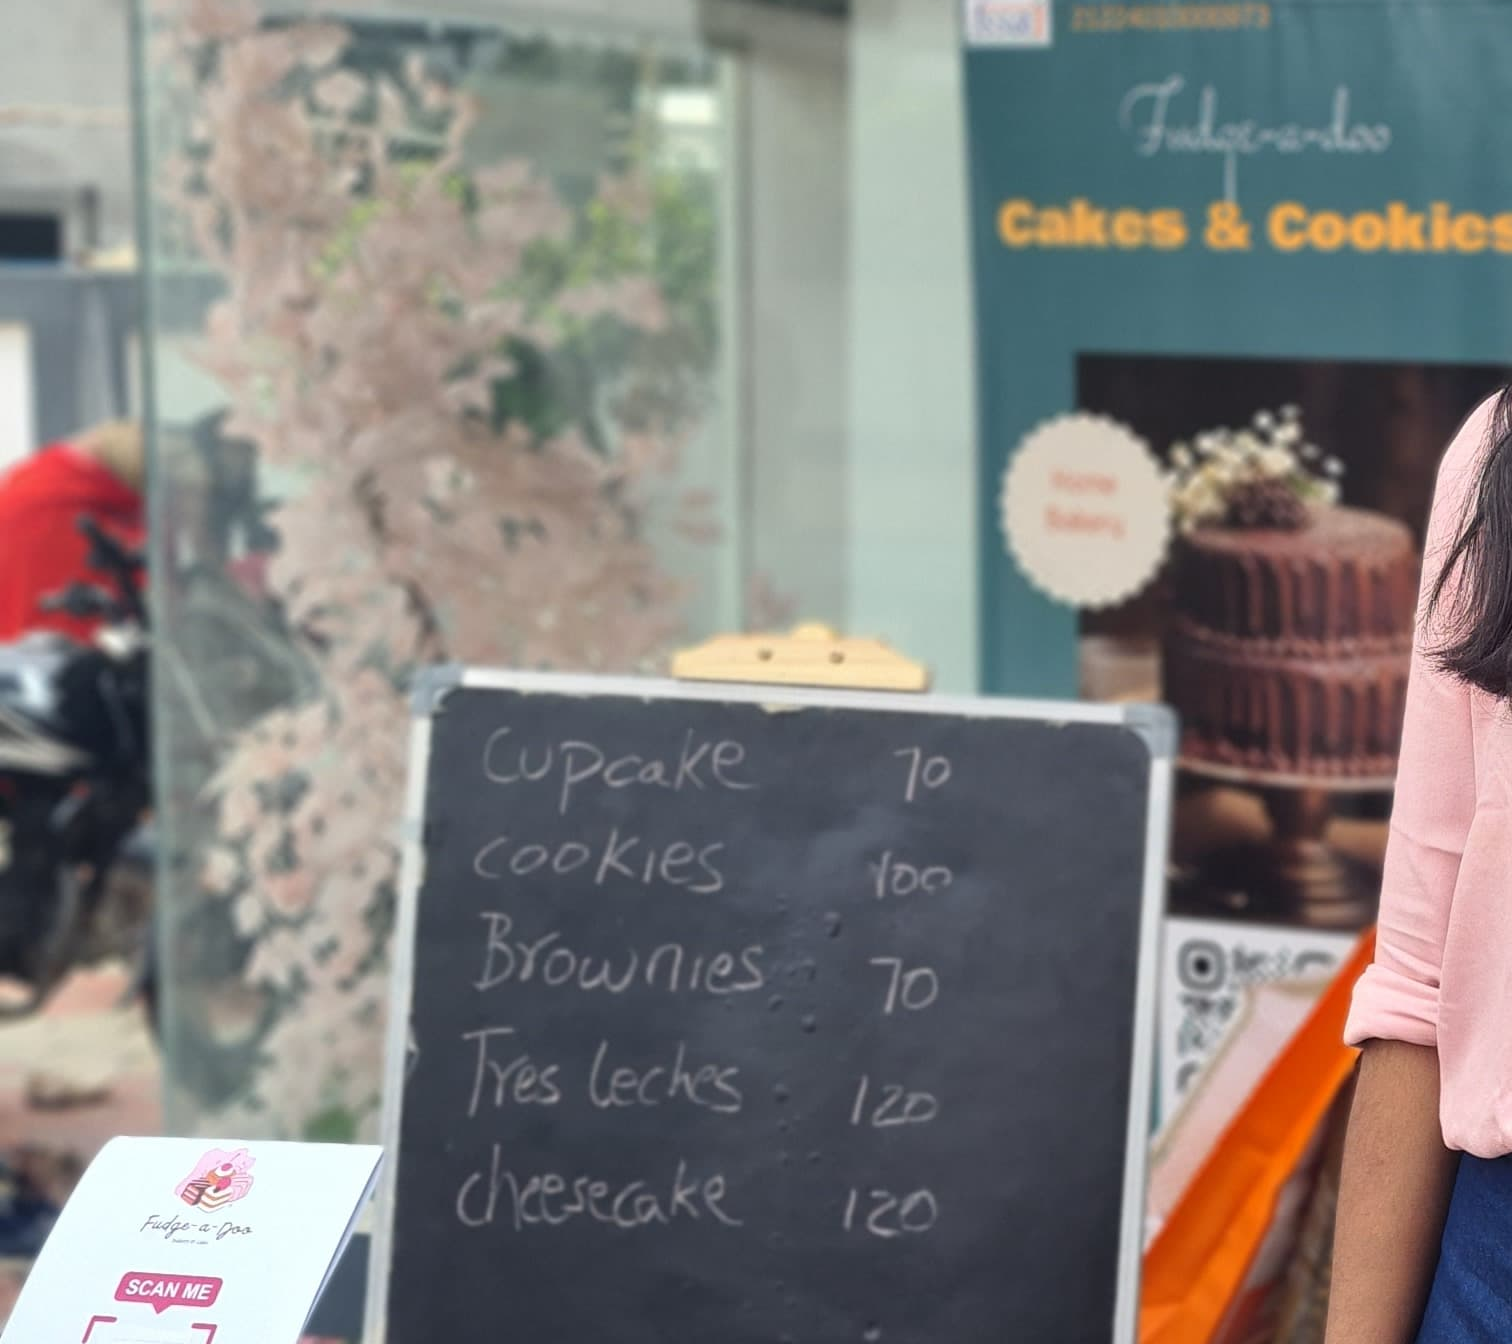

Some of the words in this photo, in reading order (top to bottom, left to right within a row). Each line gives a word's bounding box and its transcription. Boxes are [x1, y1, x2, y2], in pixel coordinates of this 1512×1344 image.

[998, 198, 1186, 248] Cakes
[1206, 201, 1250, 250] &
[482, 728, 759, 814] Cupcake
[894, 747, 950, 802] 70
[869, 850, 951, 898] 100
[474, 912, 764, 993] Brownies
[870, 957, 939, 1013] 70
[463, 1026, 561, 1117] Tres
[851, 1076, 937, 1127] 120
[140, 1215, 253, 1240] Fudge-a-Doo
[843, 1189, 937, 1236] 120
[125, 1279, 178, 1299] SCAN
[183, 1284, 213, 1301] ME
